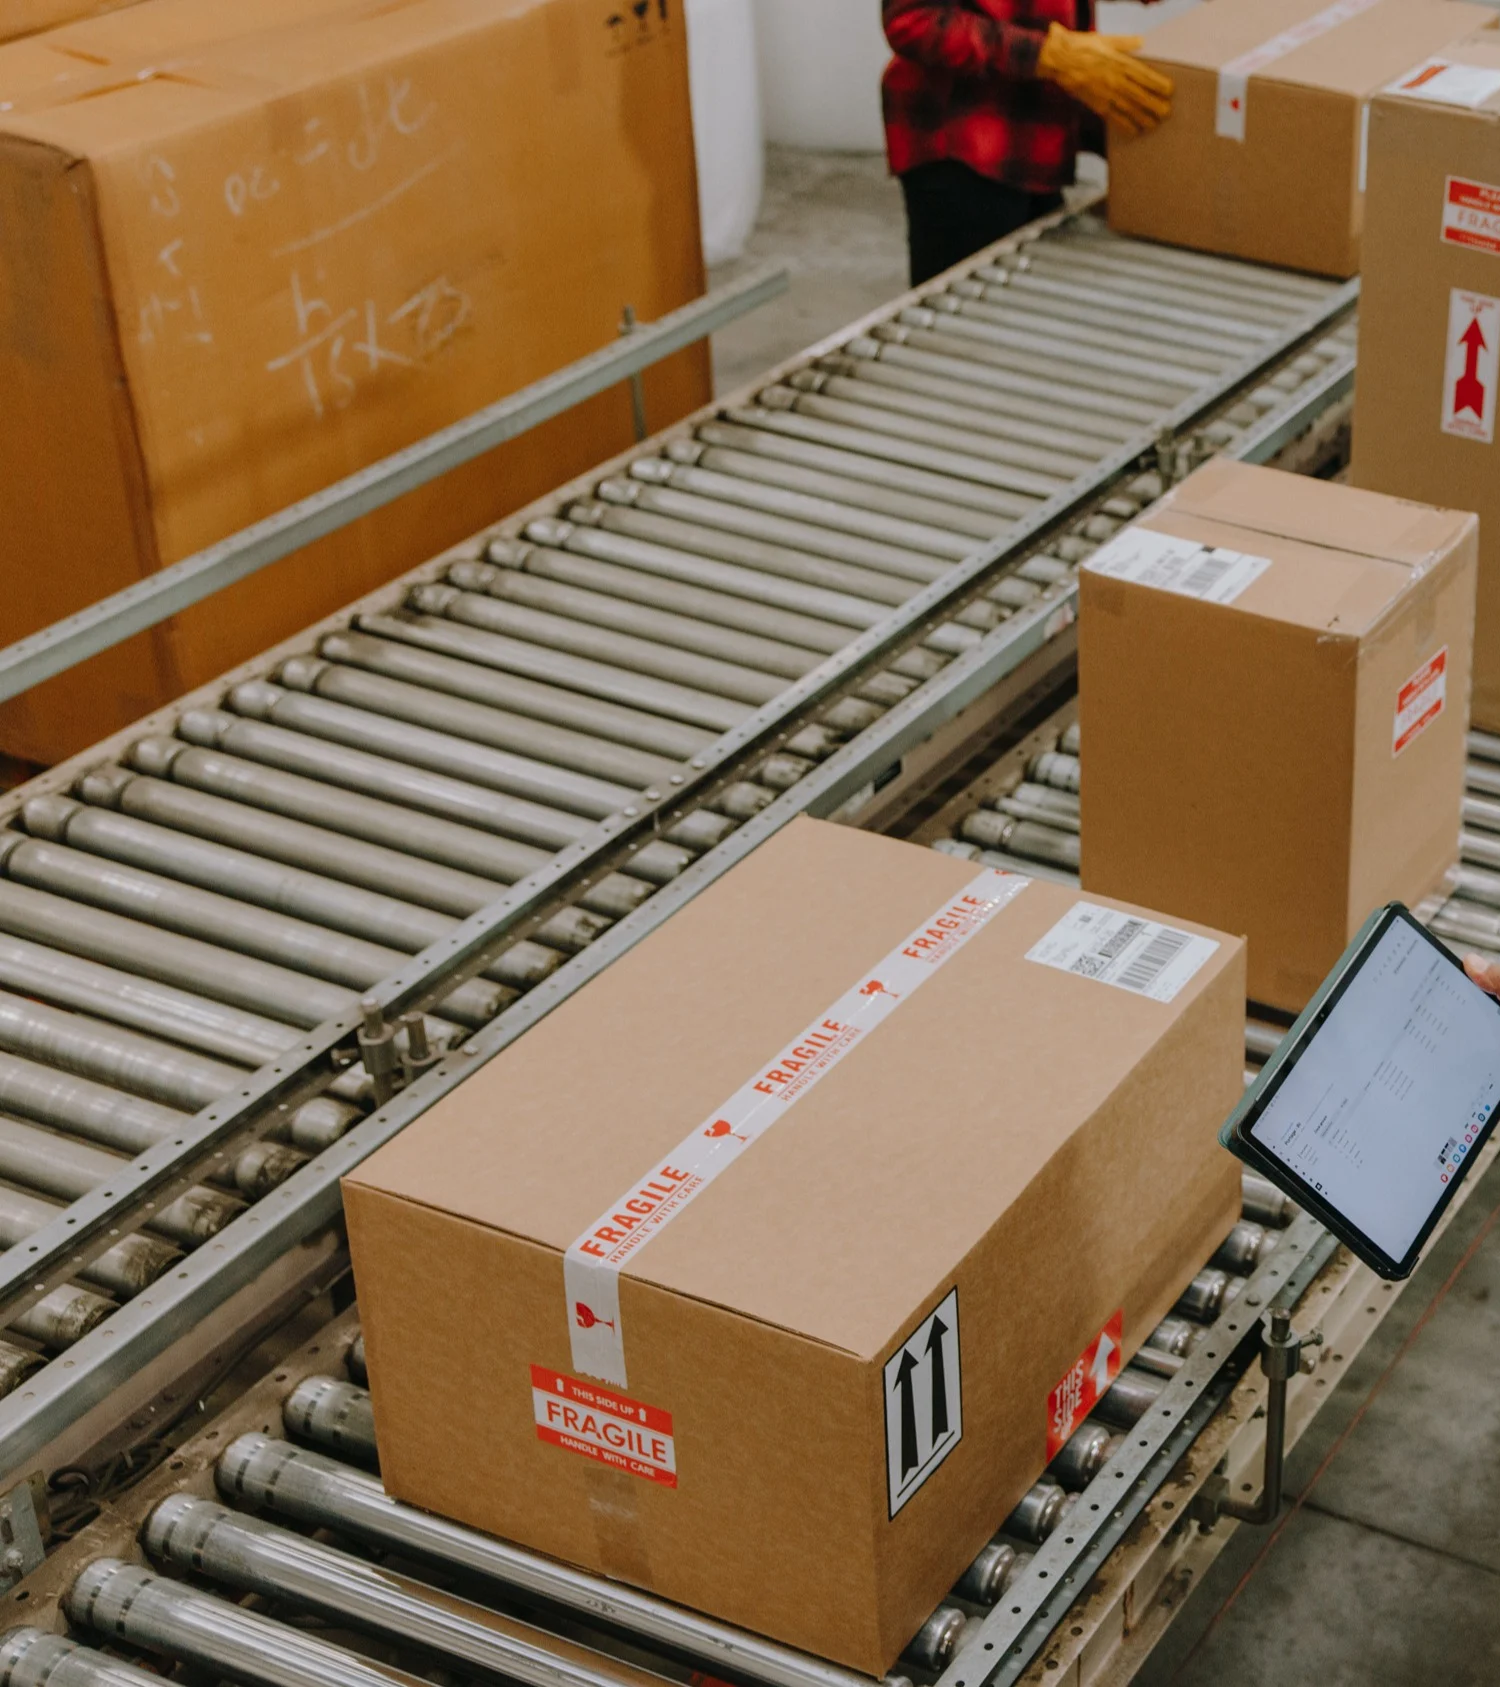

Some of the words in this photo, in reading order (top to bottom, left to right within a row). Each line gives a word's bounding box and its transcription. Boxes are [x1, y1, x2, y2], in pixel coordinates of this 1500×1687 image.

[902, 895, 985, 958] FRAGILE
[753, 1018, 850, 1095] FRAGILE
[579, 1165, 690, 1258] FRAGILE
[610, 1226, 653, 1265] HANDLE
[651, 1200, 679, 1225] WITH
[677, 1175, 705, 1200] CARE
[571, 1386, 594, 1402] THIS
[596, 1395, 619, 1412] SIDE
[619, 1403, 635, 1416] UP
[1053, 1377, 1083, 1434] SIDE
[1054, 1359, 1084, 1409] THIS
[546, 1400, 667, 1464] FRAGILE
[560, 1435, 598, 1457] HANDLE
[602, 1450, 627, 1468] WITH
[630, 1461, 656, 1478] CARE
